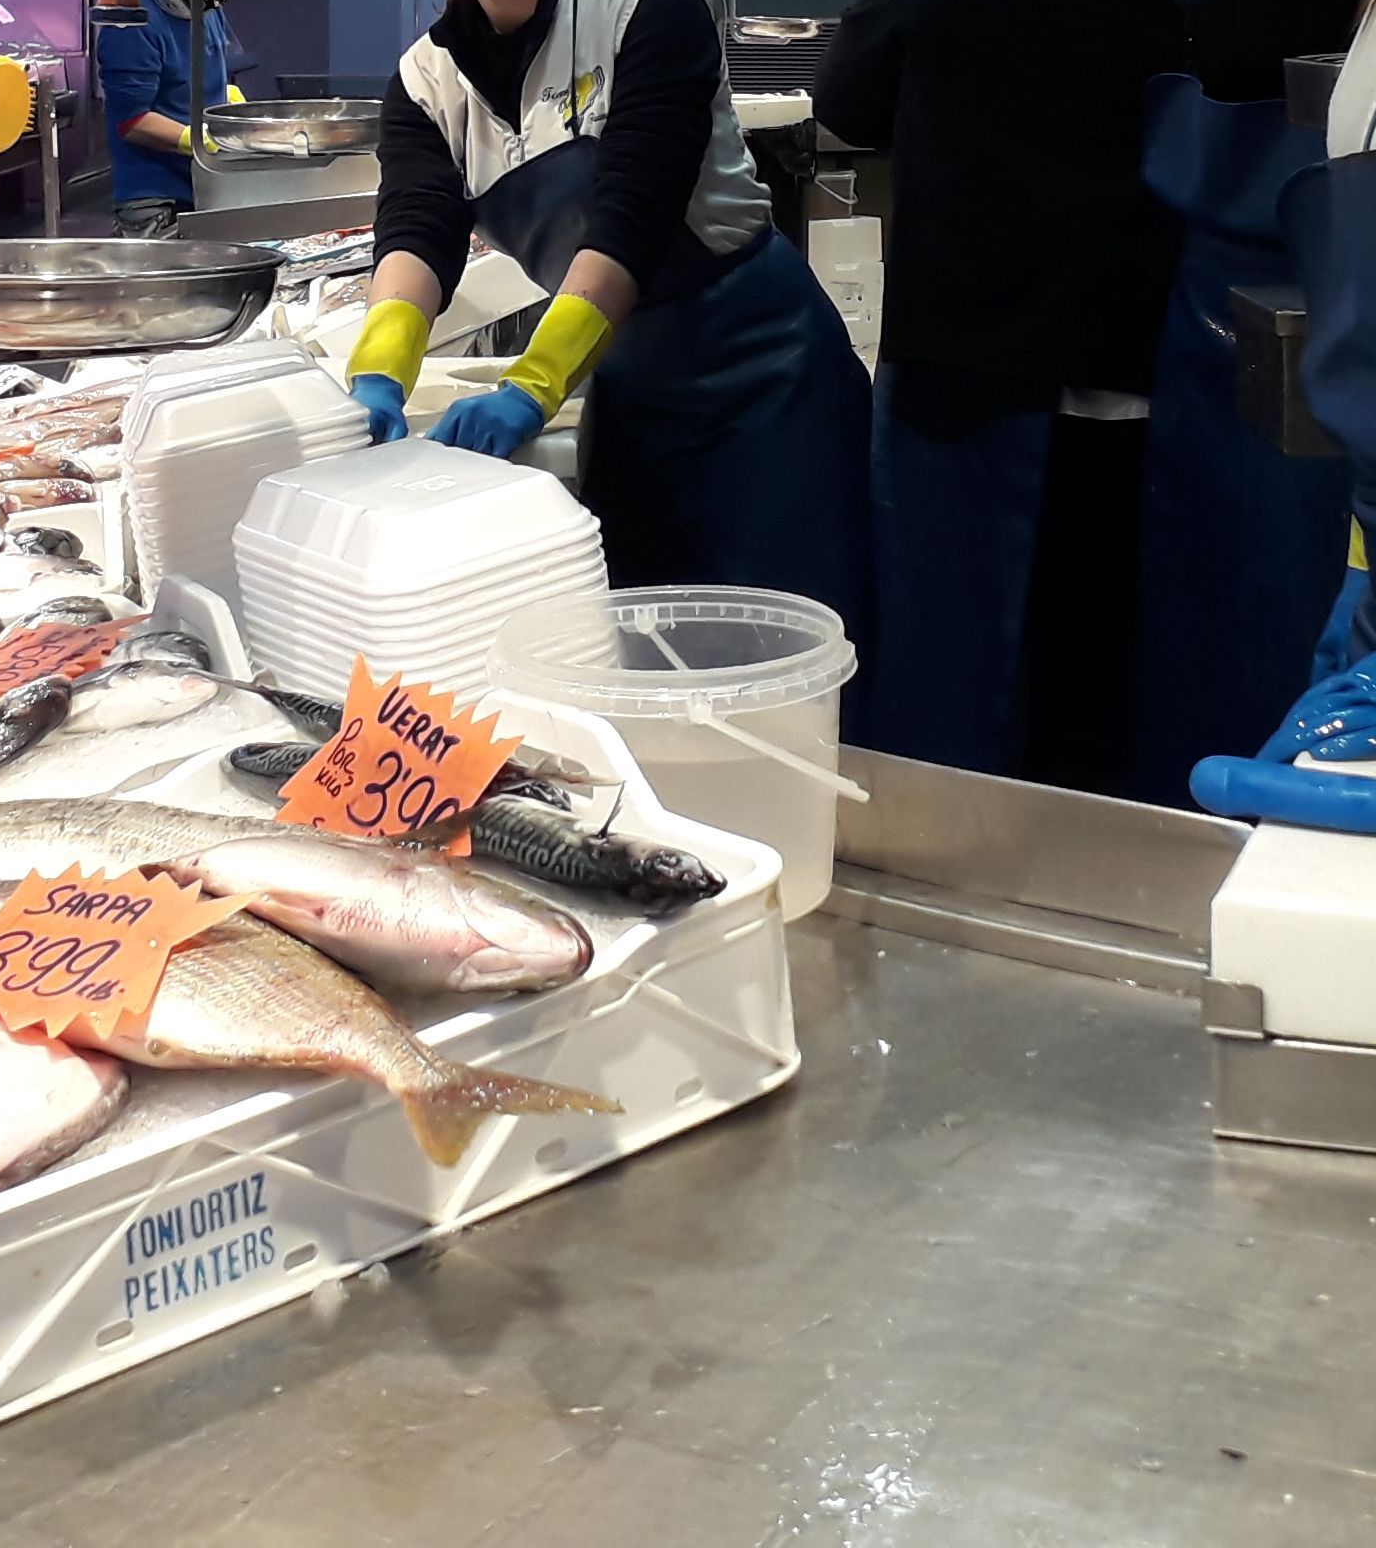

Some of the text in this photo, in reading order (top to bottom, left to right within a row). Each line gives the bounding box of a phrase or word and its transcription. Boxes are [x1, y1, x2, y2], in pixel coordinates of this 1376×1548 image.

[376, 685, 461, 765] VERAT
[23, 883, 154, 927] SARPA
[125, 1170, 268, 1266] TONI ORTIZ
[124, 1224, 276, 1320] PEIXATERS
